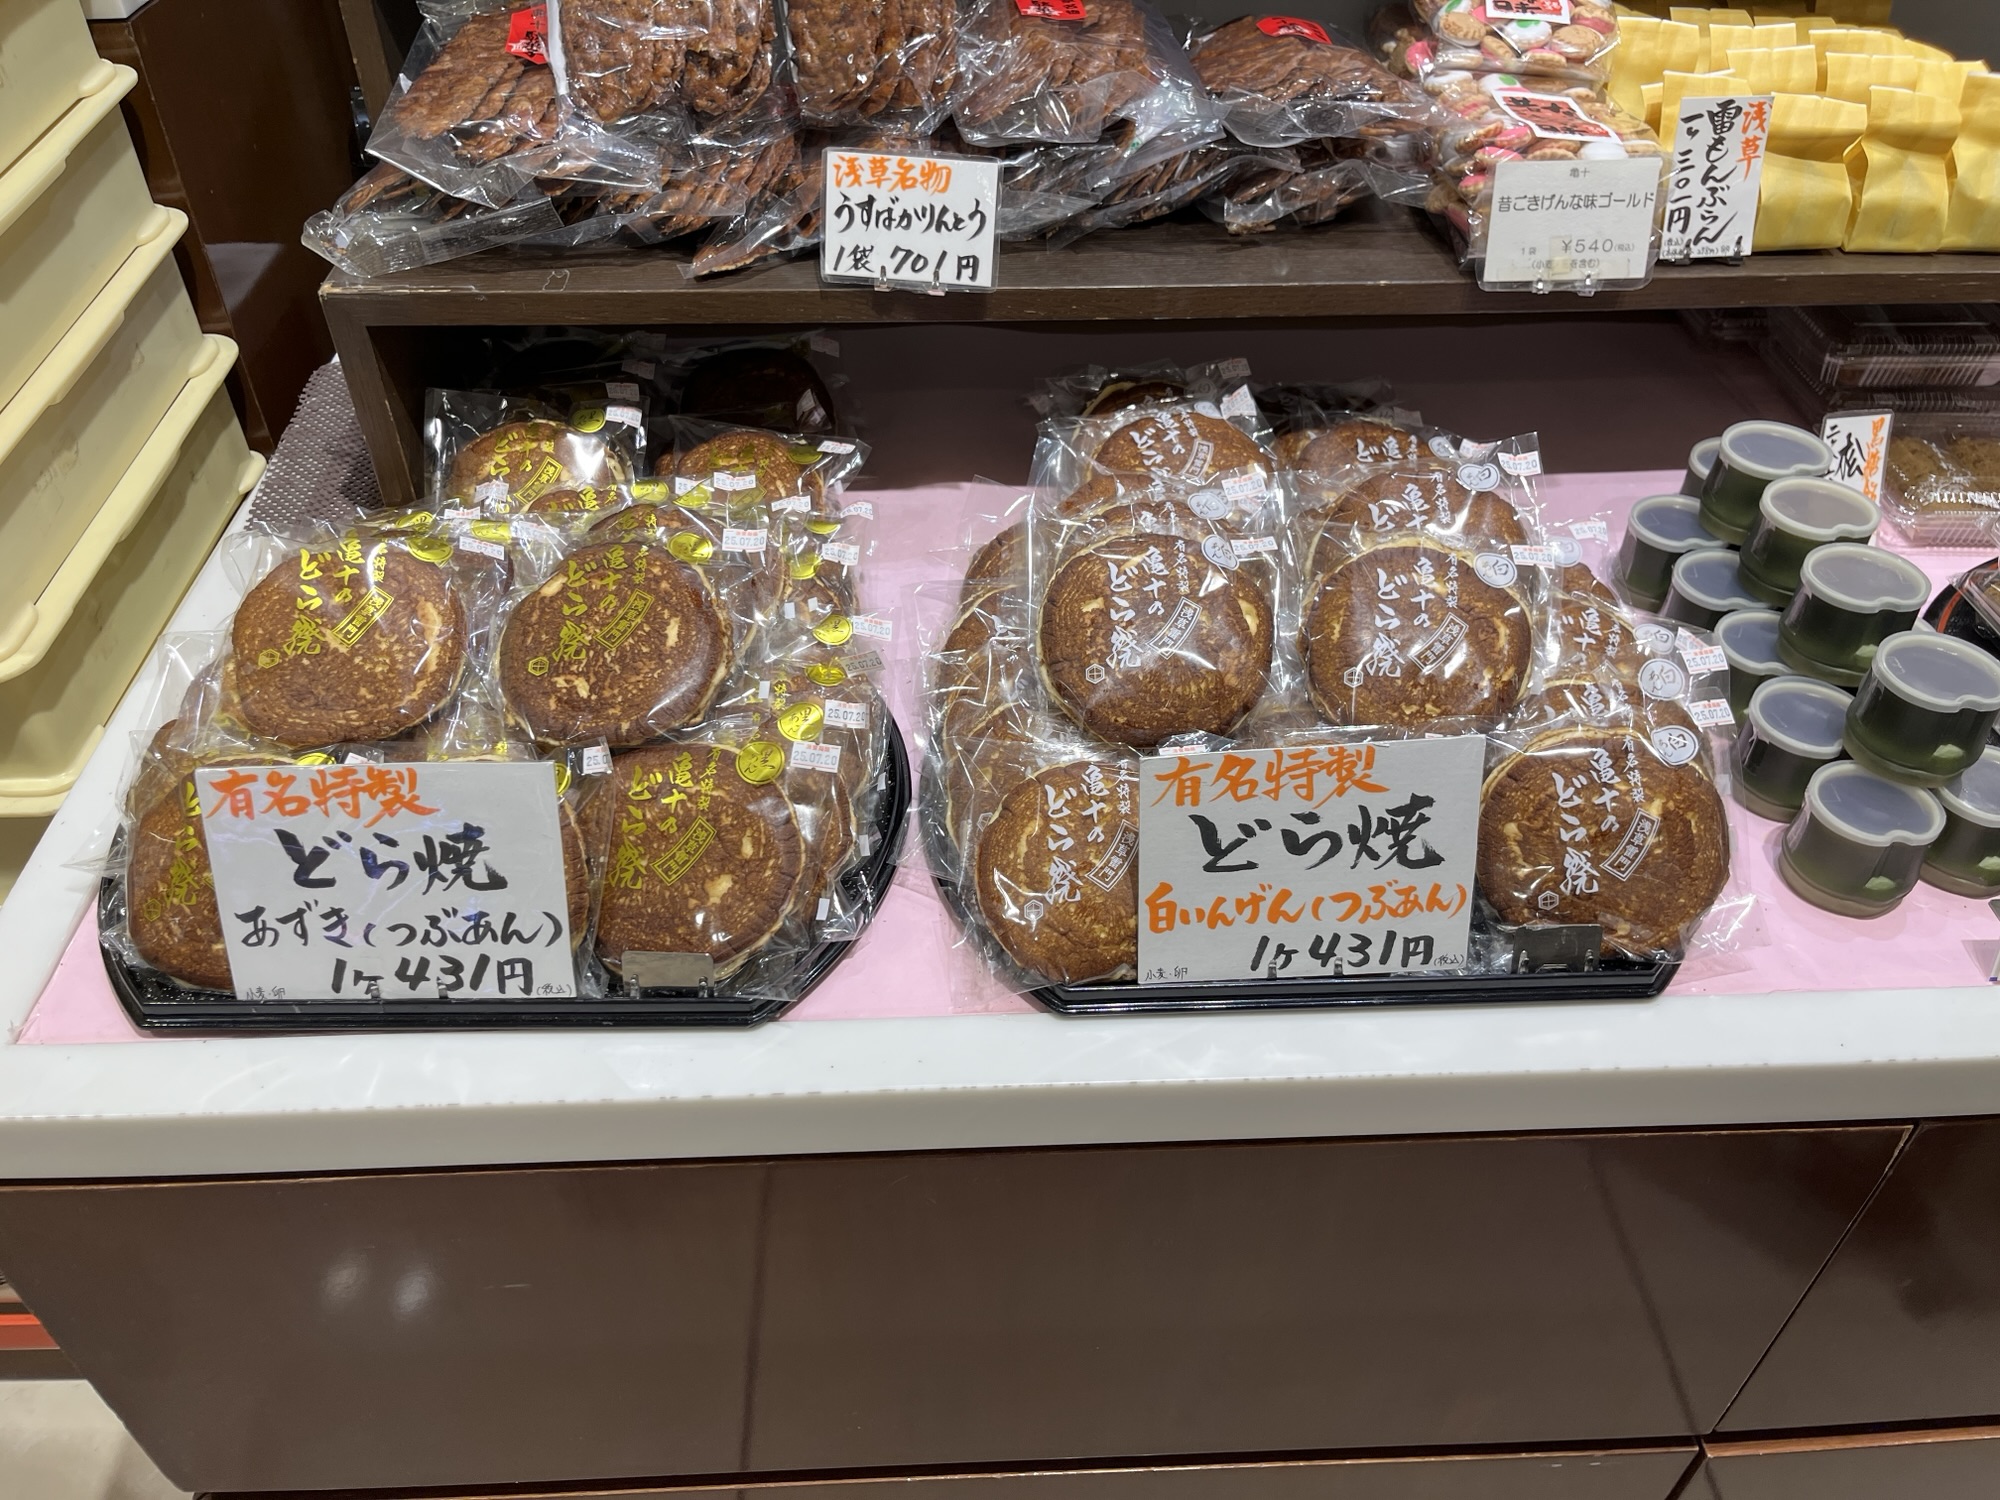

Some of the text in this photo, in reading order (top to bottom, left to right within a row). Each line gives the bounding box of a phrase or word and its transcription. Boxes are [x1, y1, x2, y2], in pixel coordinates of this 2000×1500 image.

[1736, 101, 1773, 183] 浅草
[833, 154, 952, 195] 浅草名物
[1569, 167, 1591, 178] 亀十
[1693, 99, 1743, 246] 雷もんぶらん
[834, 191, 987, 241] うすばかりんとう
[1498, 192, 1655, 212] 昔ごきげんな味ゴールド
[833, 244, 980, 282] 1袋 701円
[1501, 458, 1538, 470] 25.07.20
[1225, 478, 1264, 496] 25.07.20
[724, 535, 766, 548] 25.07.20
[854, 621, 891, 636] 25.07.20
[1685, 653, 1725, 669] 25.07.20
[828, 708, 866, 722] 25.07.20
[1694, 707, 1732, 723] 25.07.20
[792, 751, 838, 766] 25.07.20
[1150, 745, 1391, 809] 有名特製
[1620, 735, 1646, 803] 有名特製
[206, 767, 442, 828] 有名特製
[1081, 764, 1111, 843] 亀十の
[1590, 747, 1622, 832] 亀十の
[1187, 792, 1446, 872] どら焼
[274, 822, 508, 896] どら焼
[235, 899, 565, 949] あずき(つぶあん)
[1144, 879, 1468, 934] 白いんげん(つぶあん)
